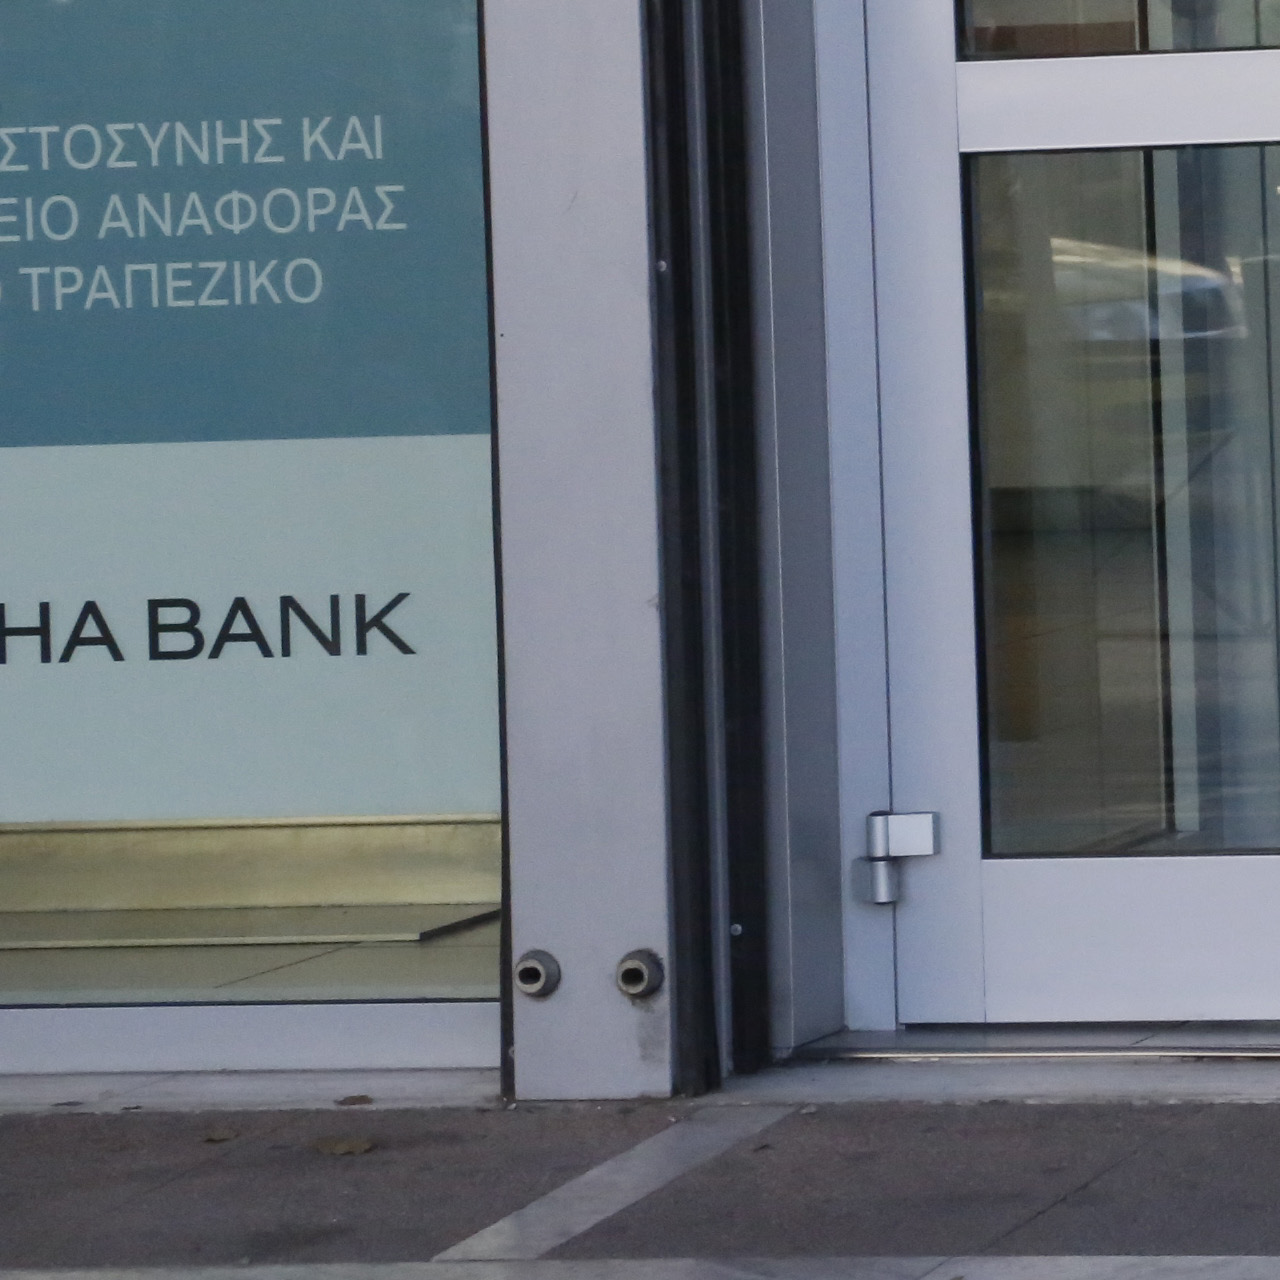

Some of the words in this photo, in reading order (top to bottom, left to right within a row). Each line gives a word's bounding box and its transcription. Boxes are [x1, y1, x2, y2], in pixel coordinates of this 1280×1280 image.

[0, 118, 285, 173] ΣΤΟΣΥΝΗΣ
[302, 115, 385, 164] ΚΑΙ
[98, 184, 409, 240] ΑΝΑΦΟΡΑΣ
[19, 257, 325, 312] ΤΡΑΠΕΖΙΚΟ
[0, 600, 126, 665] HA
[147, 592, 418, 663] BANK
